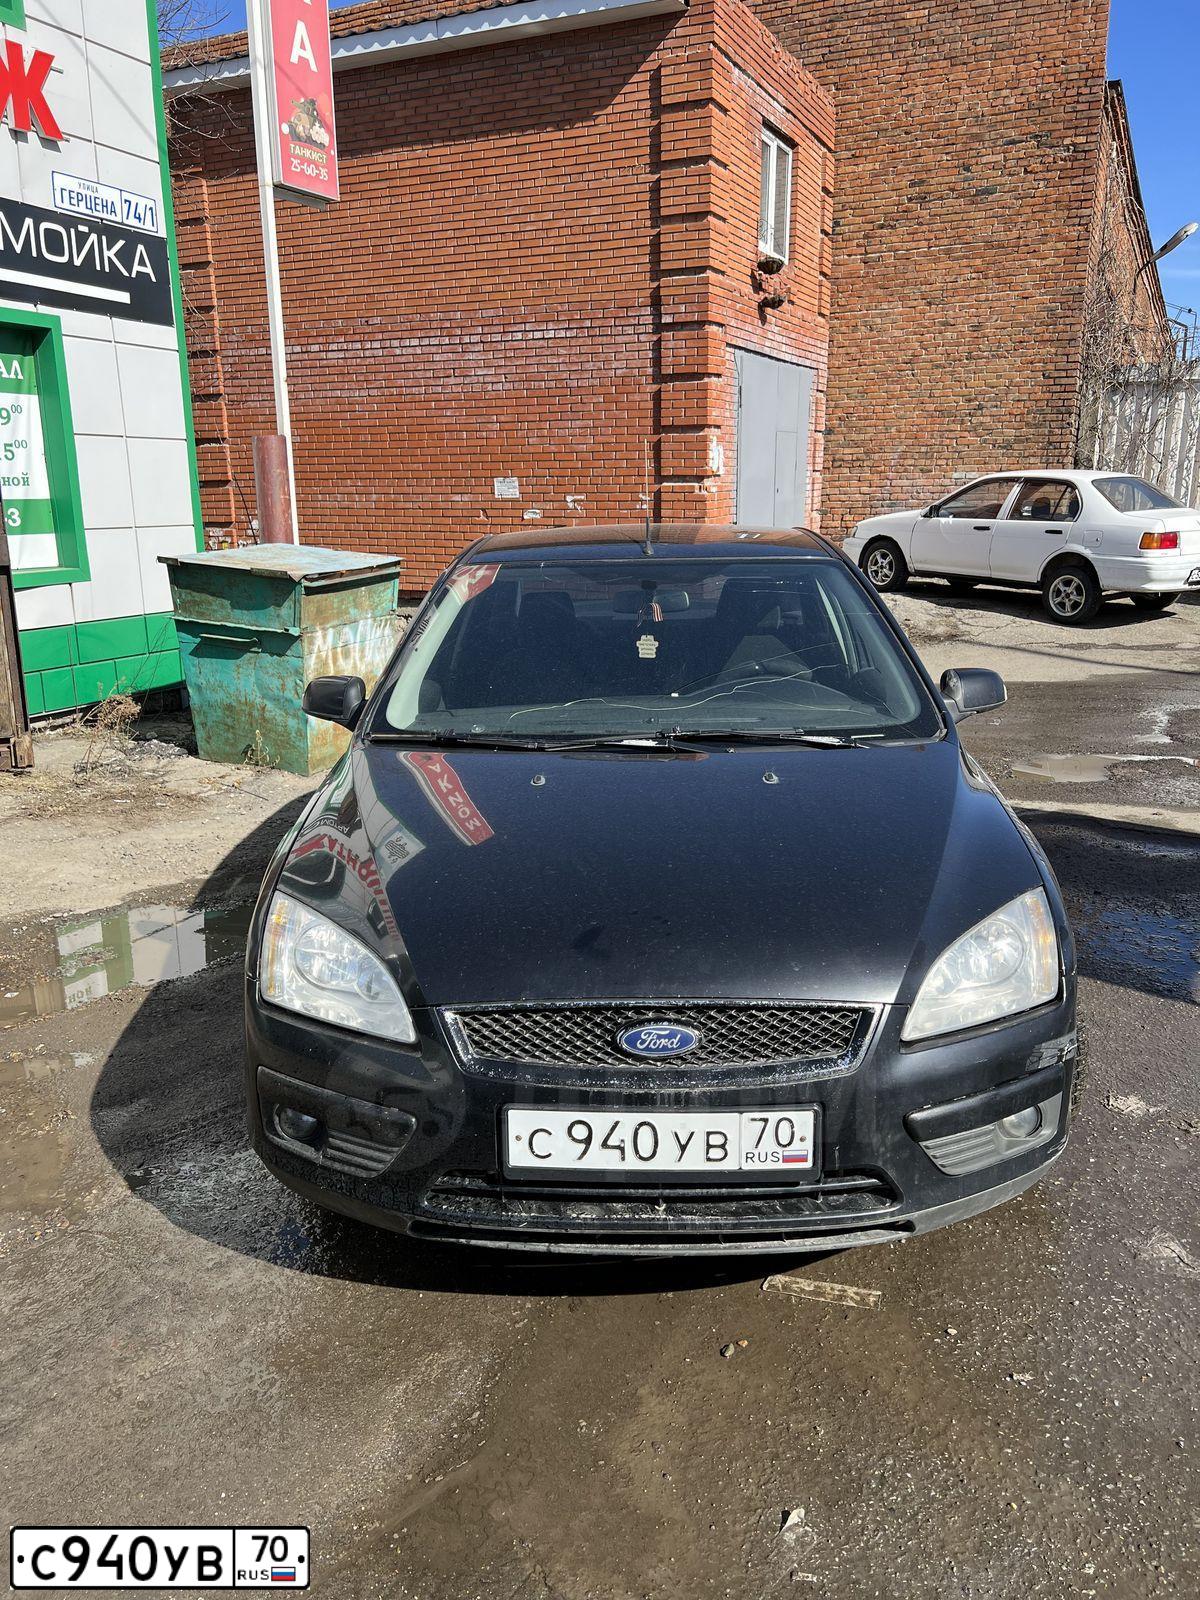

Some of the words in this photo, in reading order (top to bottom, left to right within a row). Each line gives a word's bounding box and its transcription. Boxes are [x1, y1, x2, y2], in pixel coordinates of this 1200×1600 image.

[290, 143, 327, 163] ТАНКИСТ
[290, 157, 328, 181] 25-60-35
[77, 181, 99, 194] УЛИЦА
[60, 187, 117, 217] ГЕРЦЕНА
[124, 199, 155, 227] 74/1
[0, 211, 157, 282] МОЙКА
[5, 507, 21, 527] 3
[636, 1029, 681, 1050] Ford
[750, 1117, 796, 1148] 70
[745, 1152, 780, 1163] RUS
